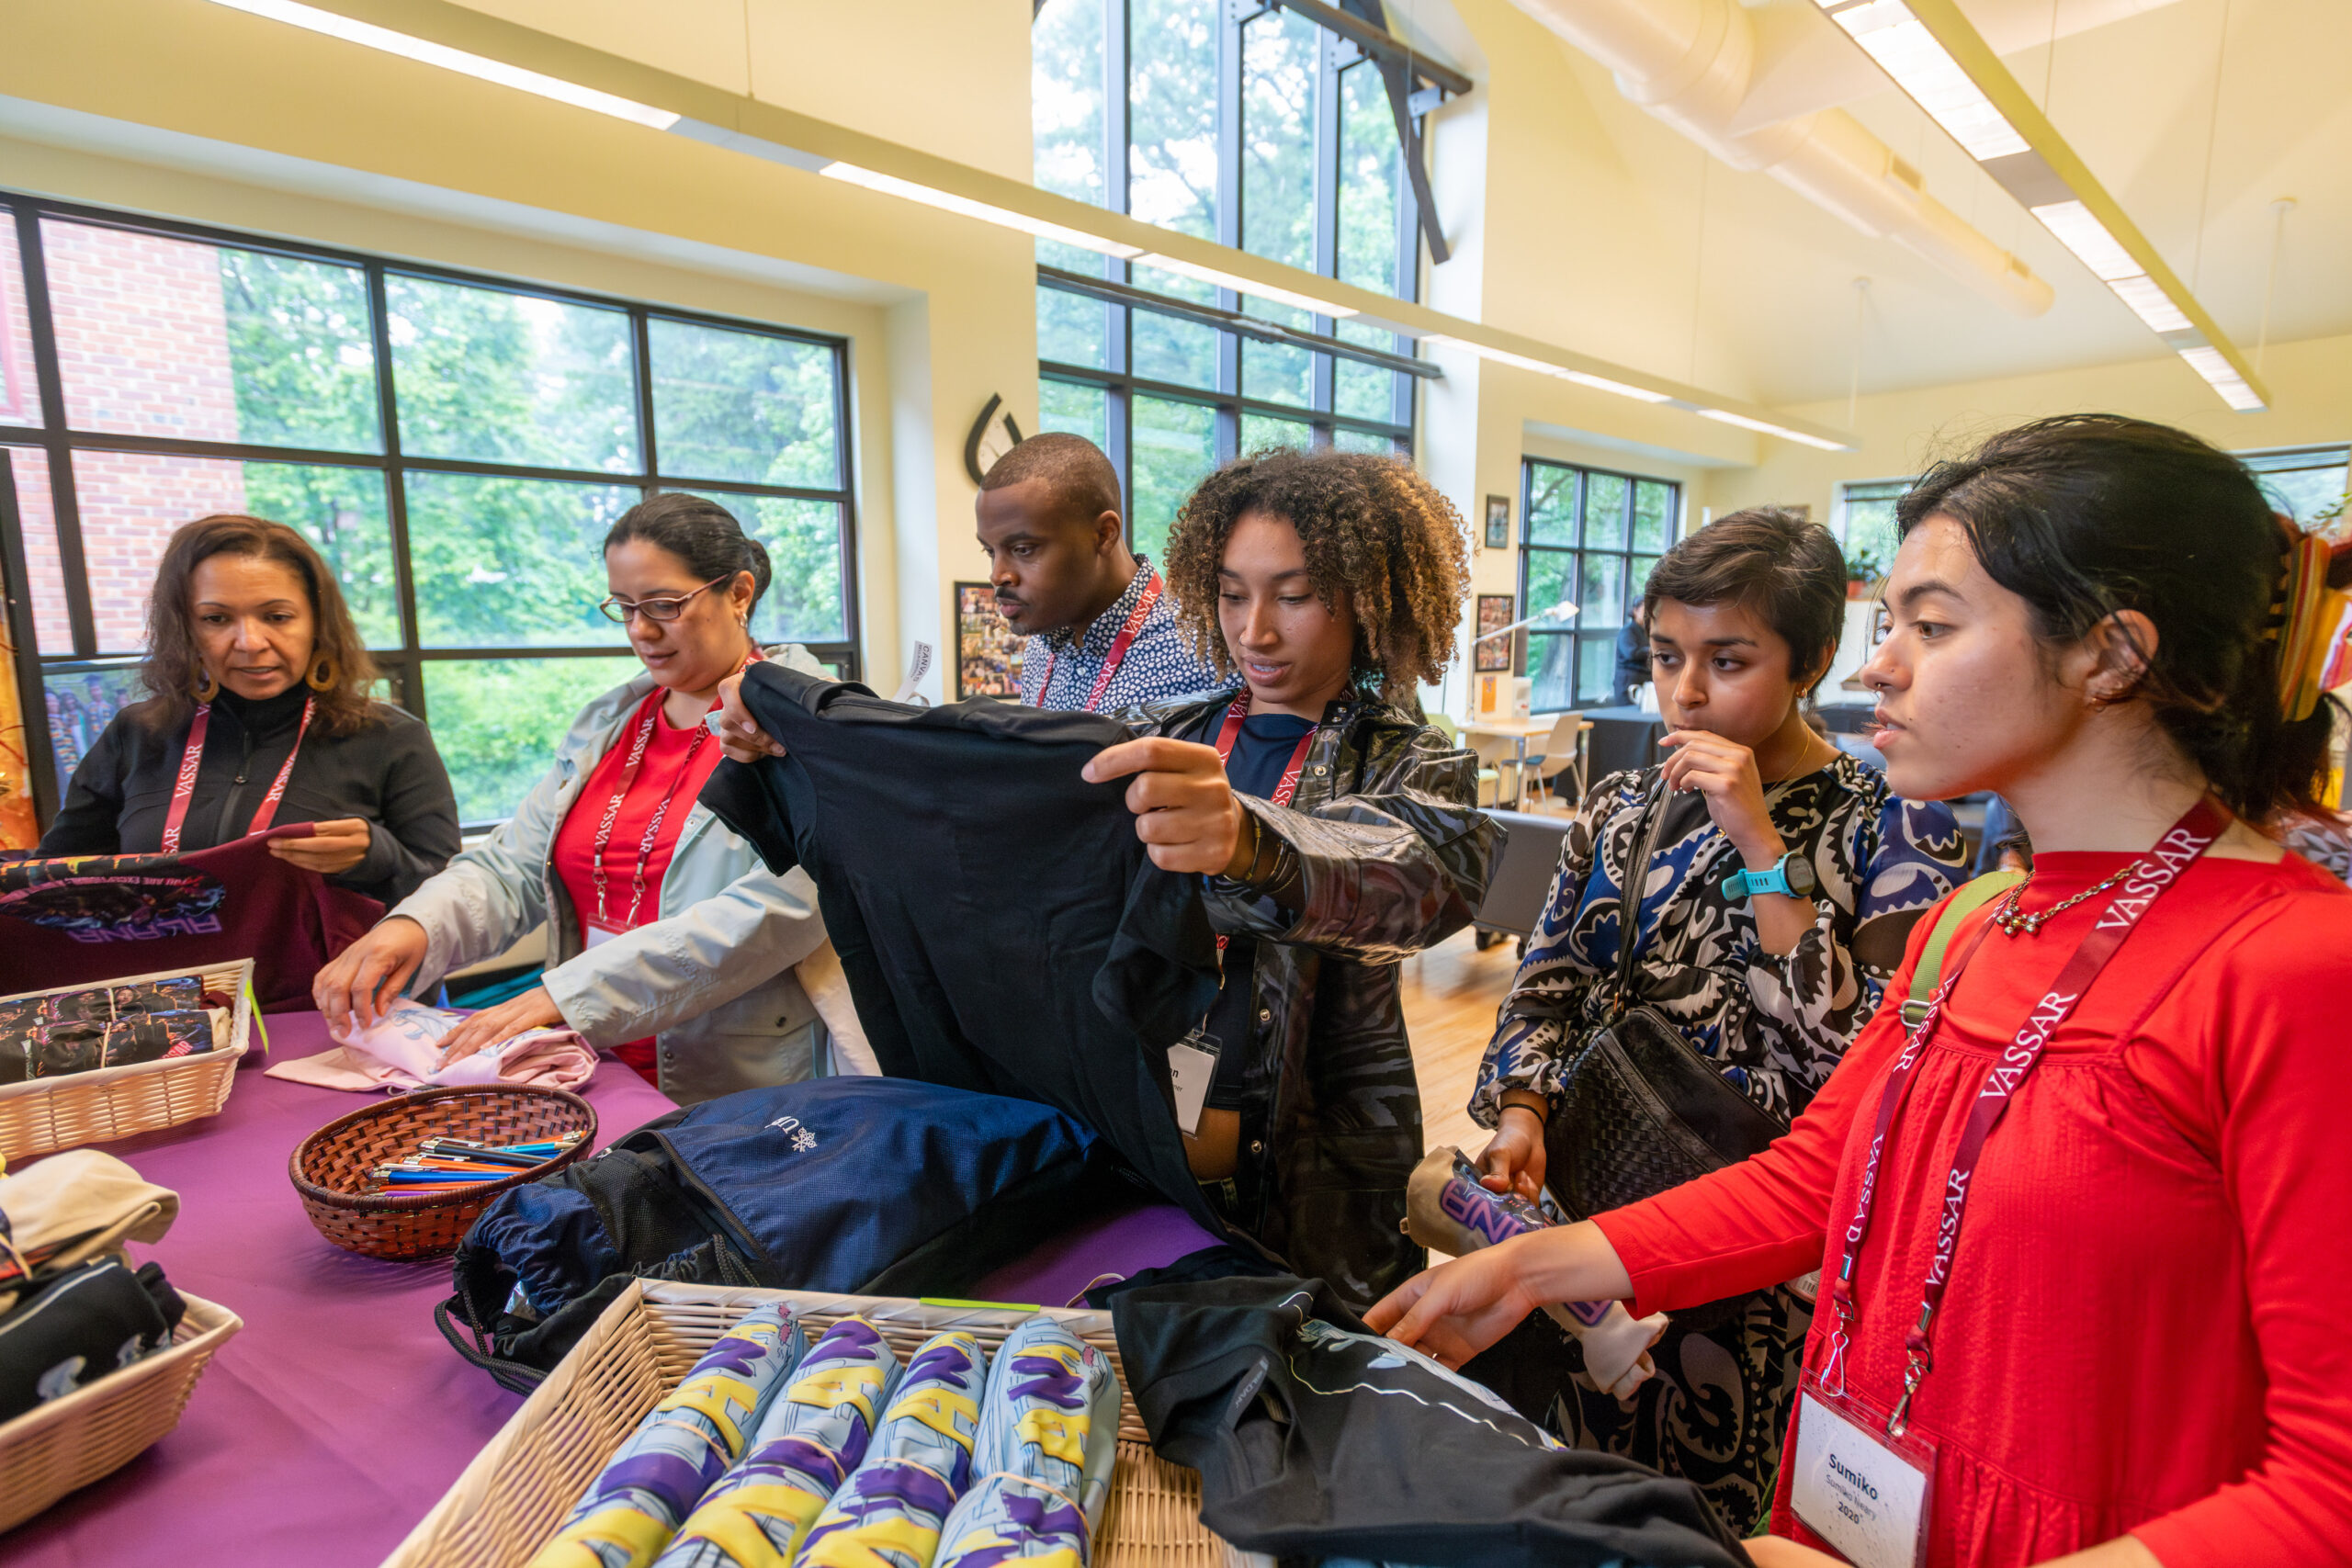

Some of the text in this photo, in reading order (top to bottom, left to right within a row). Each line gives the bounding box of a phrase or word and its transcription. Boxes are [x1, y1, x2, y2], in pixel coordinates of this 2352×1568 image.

[1121, 589, 1158, 635] VASSAR
[913, 645, 930, 682] CANVAS
[1083, 660, 1117, 712] VASSAR
[626, 716, 655, 768] VASSAR
[175, 743, 203, 798] VASSAR
[1270, 770, 1302, 807] VASS
[164, 826, 182, 854] SAR
[594, 793, 625, 847] VASSAR
[639, 797, 671, 852] VASSAR
[2095, 829, 2211, 930] VASSAR
[1893, 971, 1960, 1073] VASSAR
[1979, 991, 2078, 1099] VASSAR
[1925, 1168, 1971, 1285] VASSAR
[1828, 1453, 1879, 1501] Sumiko
[1838, 1501, 1860, 1525] 2020
